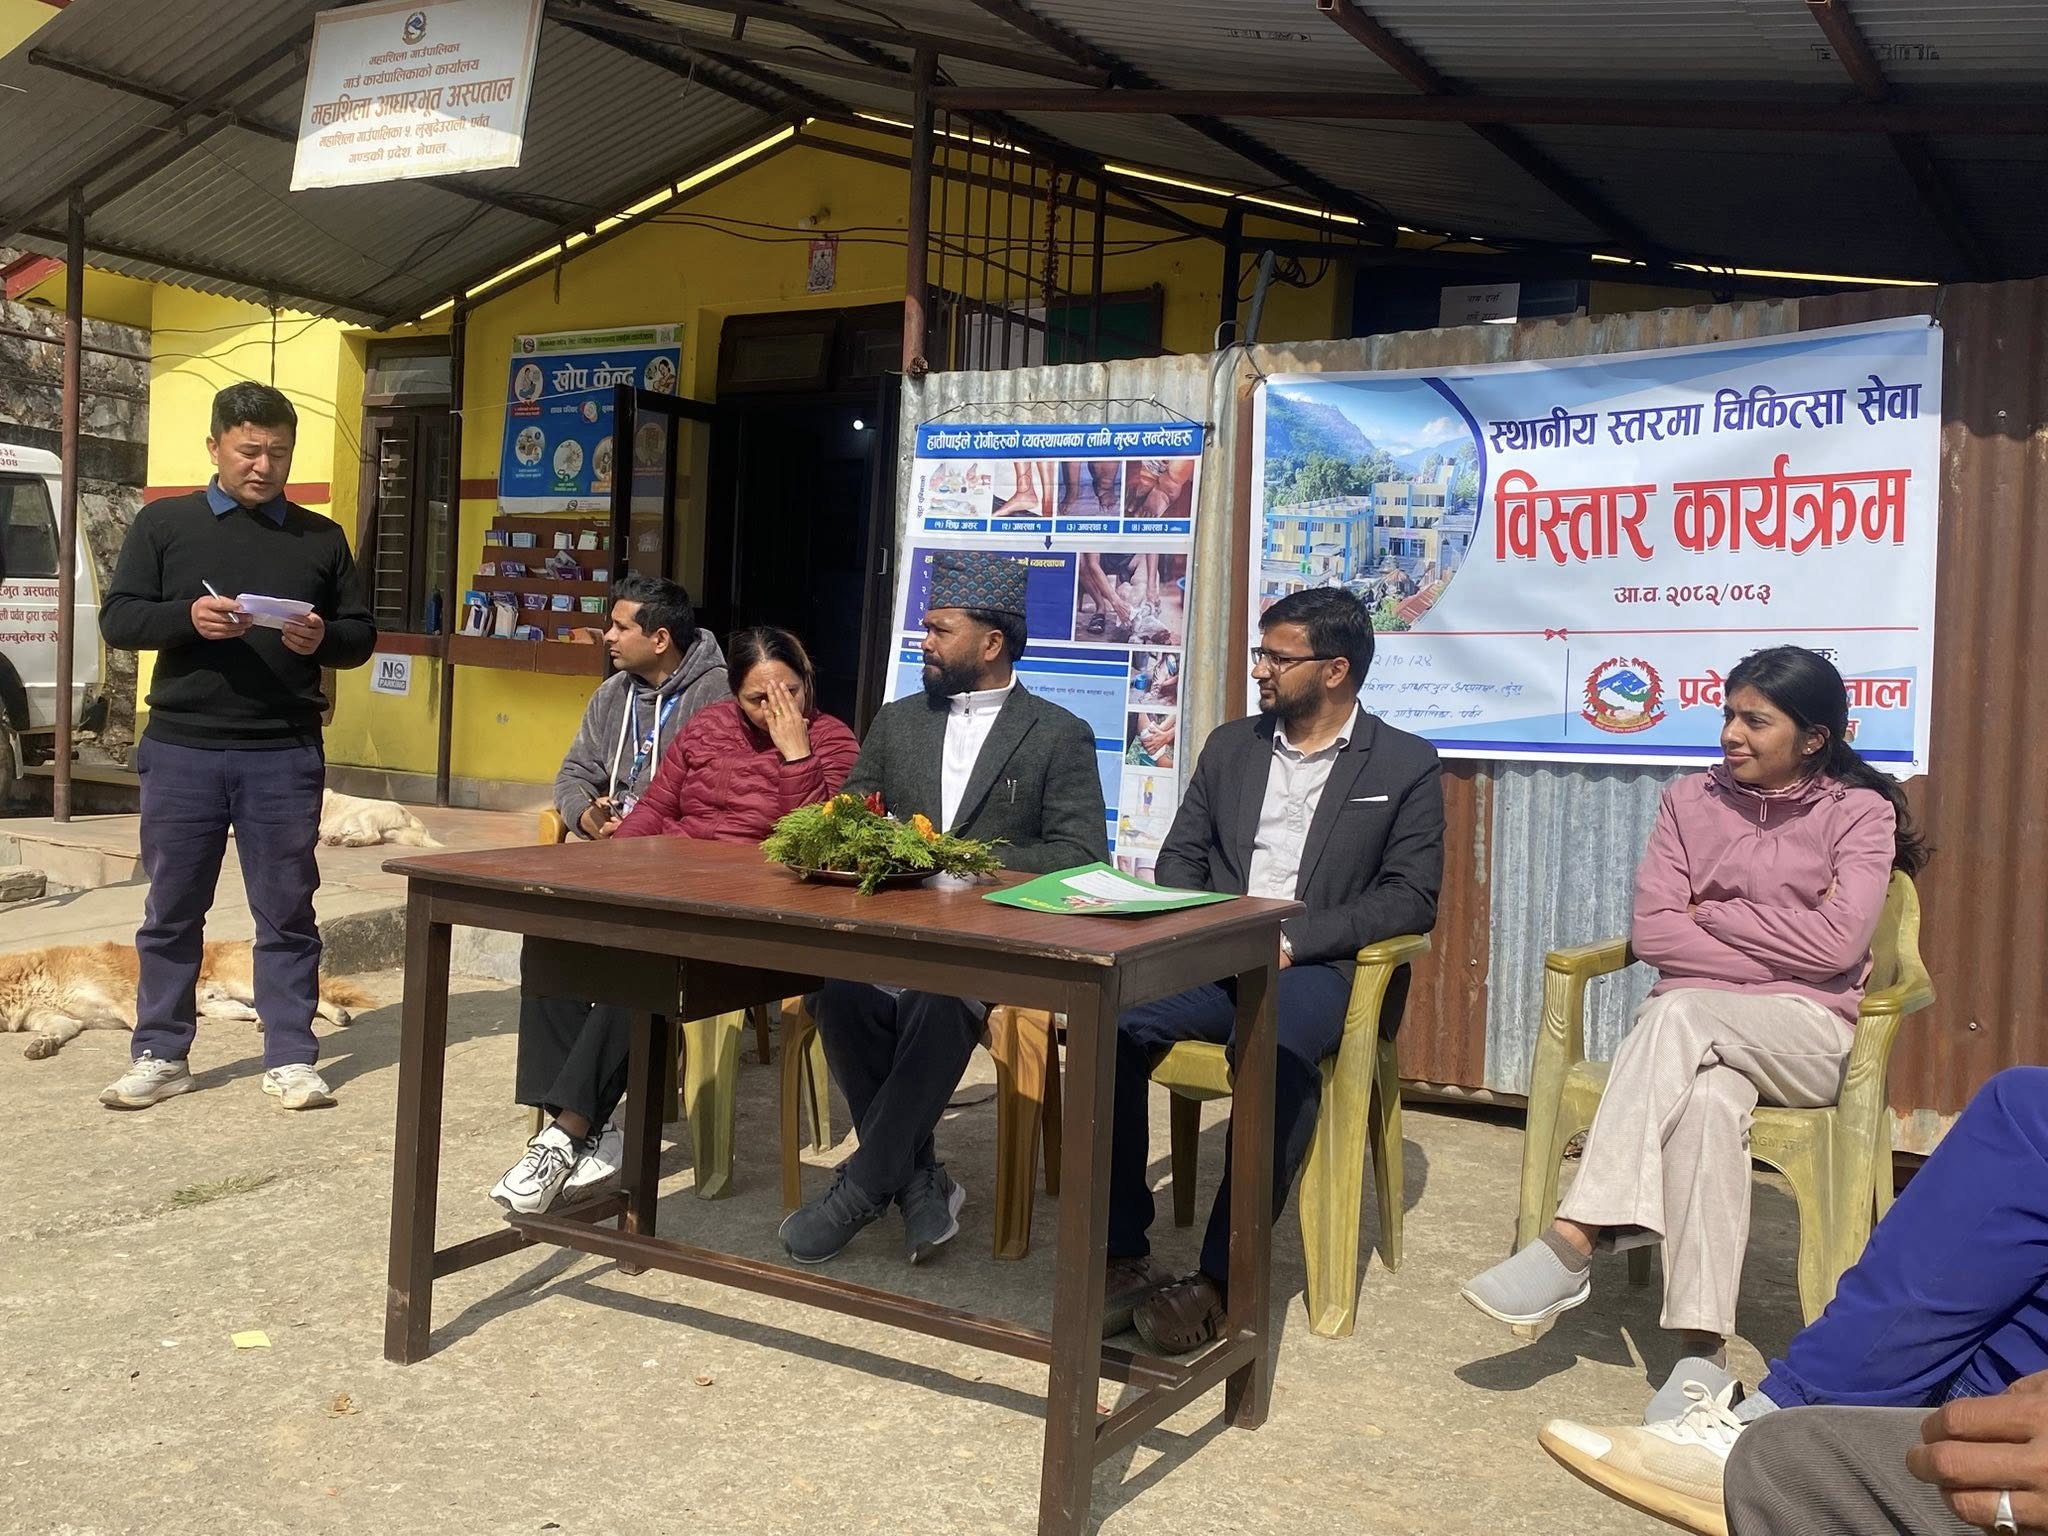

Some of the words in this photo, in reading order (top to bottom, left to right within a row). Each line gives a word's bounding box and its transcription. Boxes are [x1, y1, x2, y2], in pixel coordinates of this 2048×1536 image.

[369, 51, 407, 65] महाशिला
[363, 63, 432, 86] कार्यपालिकाको
[434, 58, 480, 76] कार्यालय
[311, 93, 372, 126] महाशिला
[375, 87, 443, 118] आधारभूत
[446, 77, 515, 108] अस्पताल
[319, 131, 355, 147] महाशिला
[349, 148, 384, 164] गण्डकी
[416, 142, 446, 156] नेपाल
[552, 363, 588, 392] खोप
[1488, 406, 1598, 453] स्थानीय
[1607, 403, 1704, 446] स्तरमा
[1713, 384, 1847, 434] चिकित्सा
[1857, 374, 1922, 426] सेवा
[1022, 432, 1084, 450] व्यवस्थापनका
[1087, 427, 1111, 448] लागि
[1113, 431, 1140, 450] मुख्य
[1494, 468, 1657, 566] विस्तार
[1672, 453, 1912, 556] कार्यक्रम
[1666, 583, 1771, 607] २०८२/०८३
[49, 630, 58, 643] से
[382, 661, 405, 679] NO
[379, 679, 405, 689] PARKING
[1678, 669, 1725, 710] प्रदे
